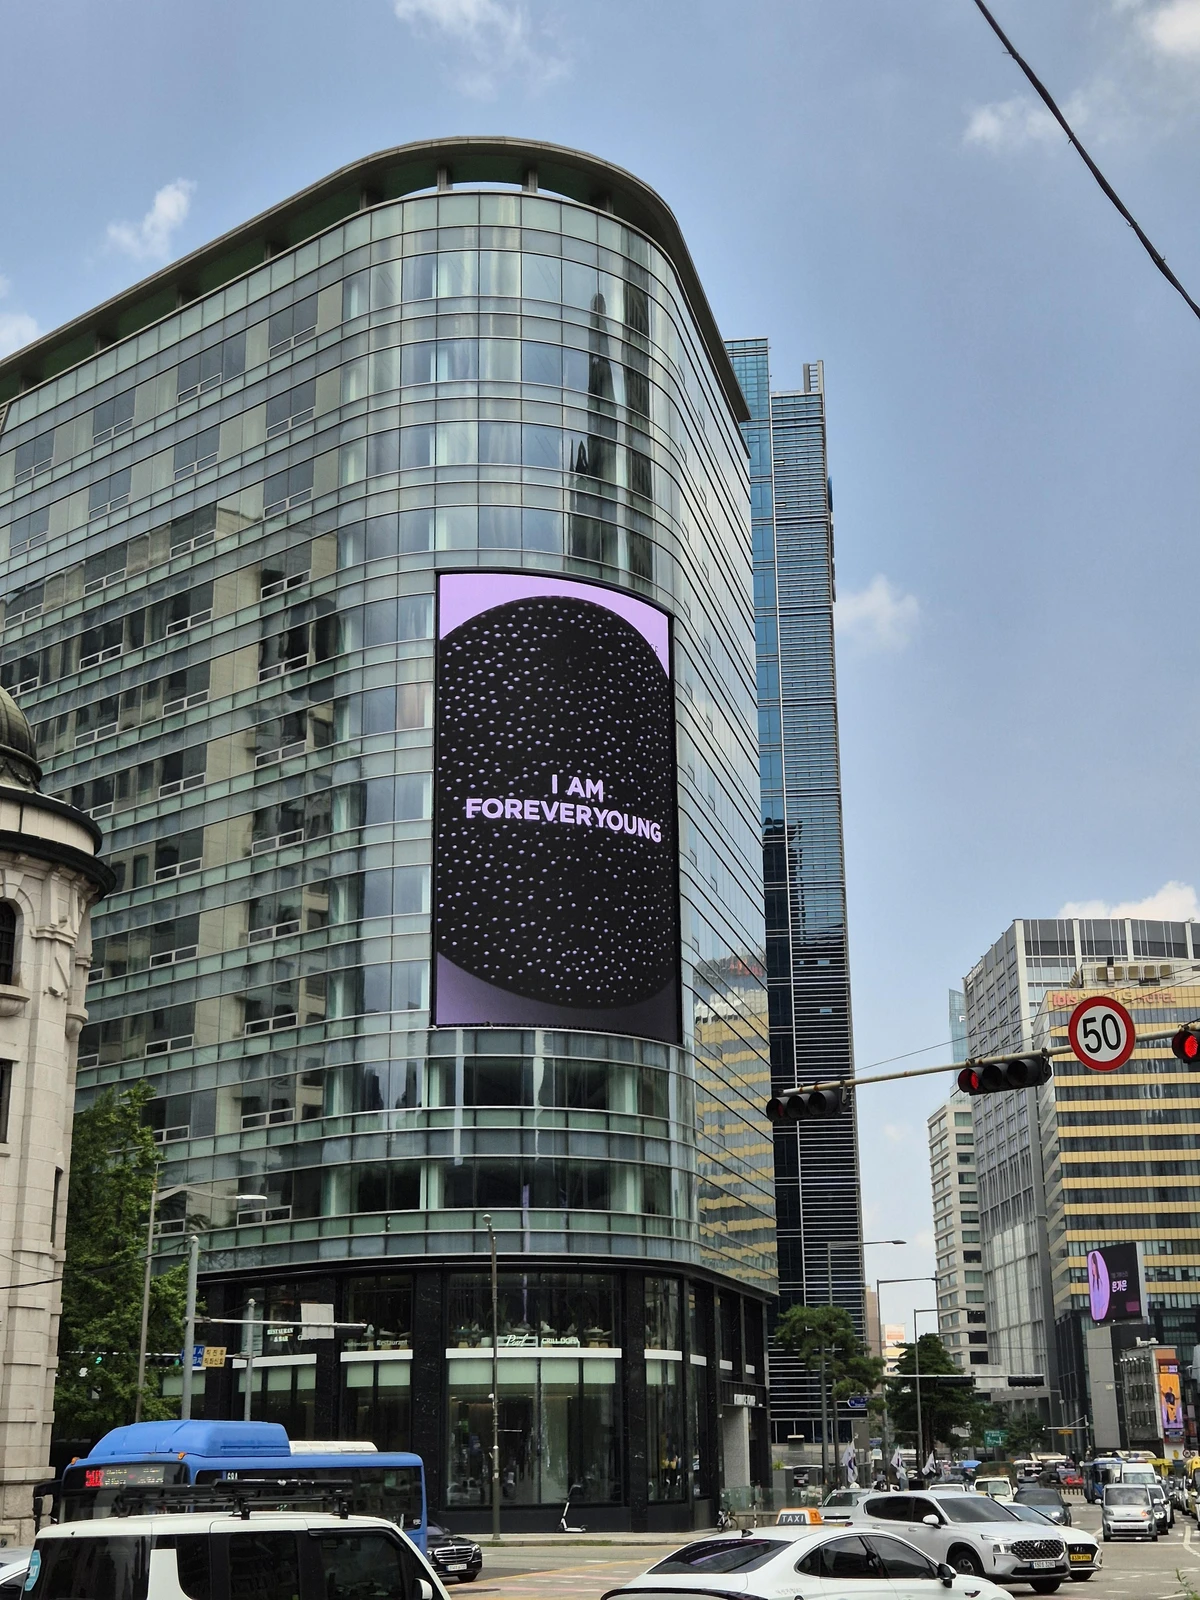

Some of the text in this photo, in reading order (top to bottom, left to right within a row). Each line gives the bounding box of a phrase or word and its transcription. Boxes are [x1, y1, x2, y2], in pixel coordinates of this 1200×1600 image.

[551, 774, 604, 803] I AM
[465, 797, 662, 843] FOREVERYOUNG
[1052, 992, 1078, 1006] ibis
[1082, 1013, 1122, 1054] 50
[376, 1339, 408, 1347] Restaurant
[781, 1515, 804, 1523] TAXI
